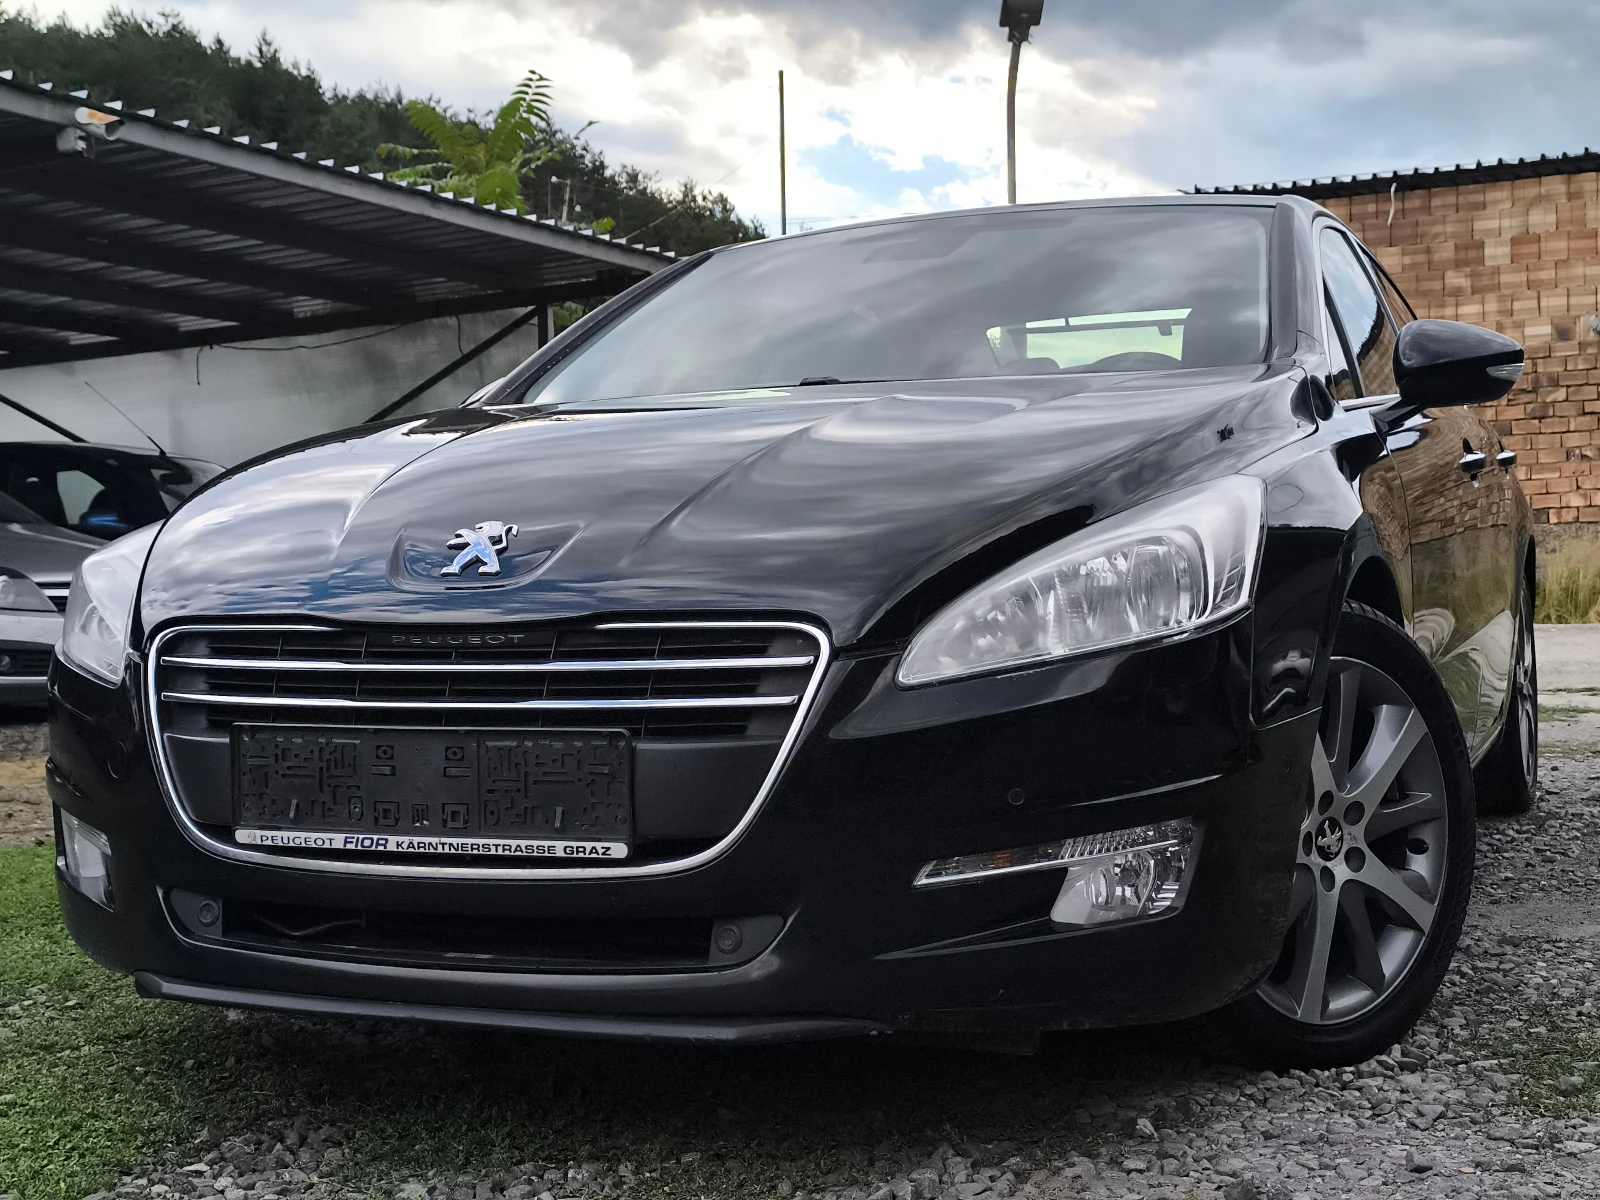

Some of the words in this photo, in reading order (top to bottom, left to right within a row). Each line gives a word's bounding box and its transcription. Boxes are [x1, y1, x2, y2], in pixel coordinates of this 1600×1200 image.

[391, 634, 525, 644] PEUGEOT
[260, 834, 336, 847] PEUGEOT
[342, 835, 389, 850] FIOR
[396, 838, 557, 855] KÄRNTNERSTRASSE
[563, 845, 612, 857] GRAZ
